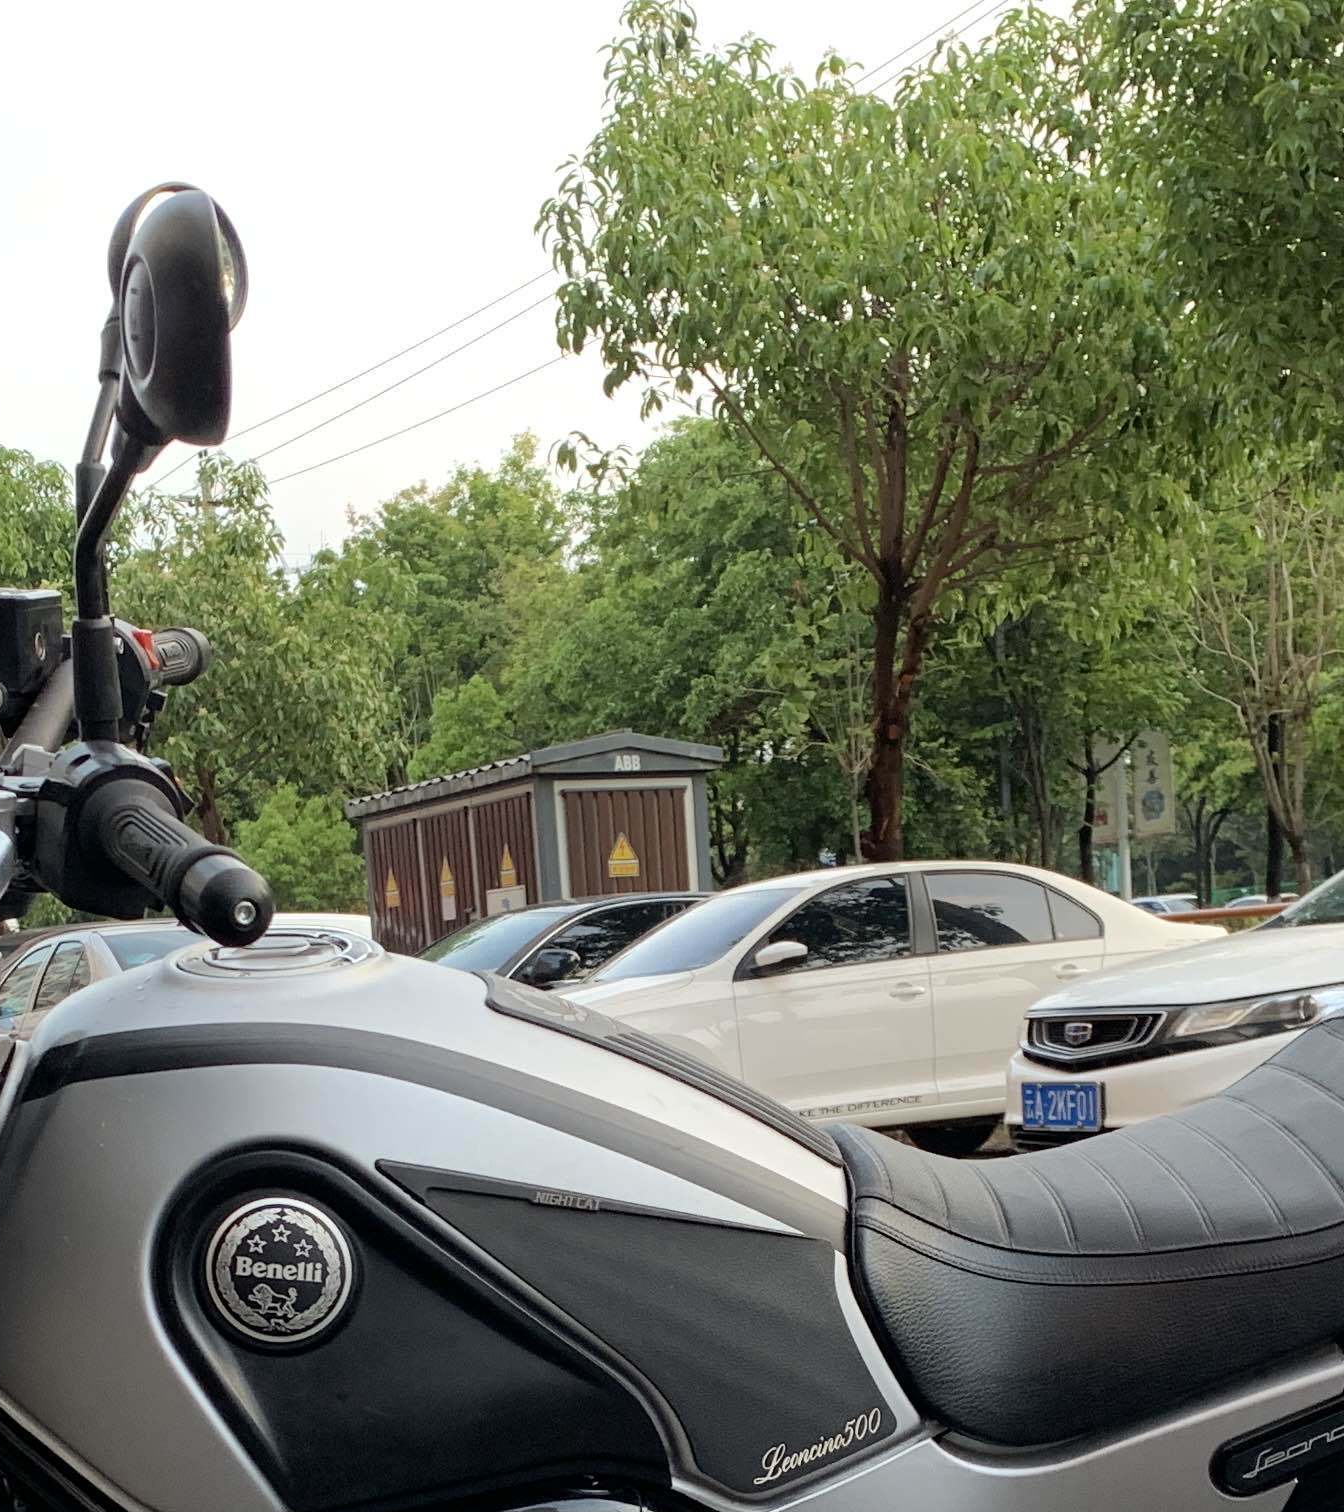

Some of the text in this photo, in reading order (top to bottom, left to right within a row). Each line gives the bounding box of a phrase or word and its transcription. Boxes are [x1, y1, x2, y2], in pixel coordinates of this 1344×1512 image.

[615, 754, 641, 771] ABB
[819, 1105, 841, 1115] THE
[847, 1096, 923, 1112] DIFFERENCE
[236, 1256, 323, 1283] Benelli
